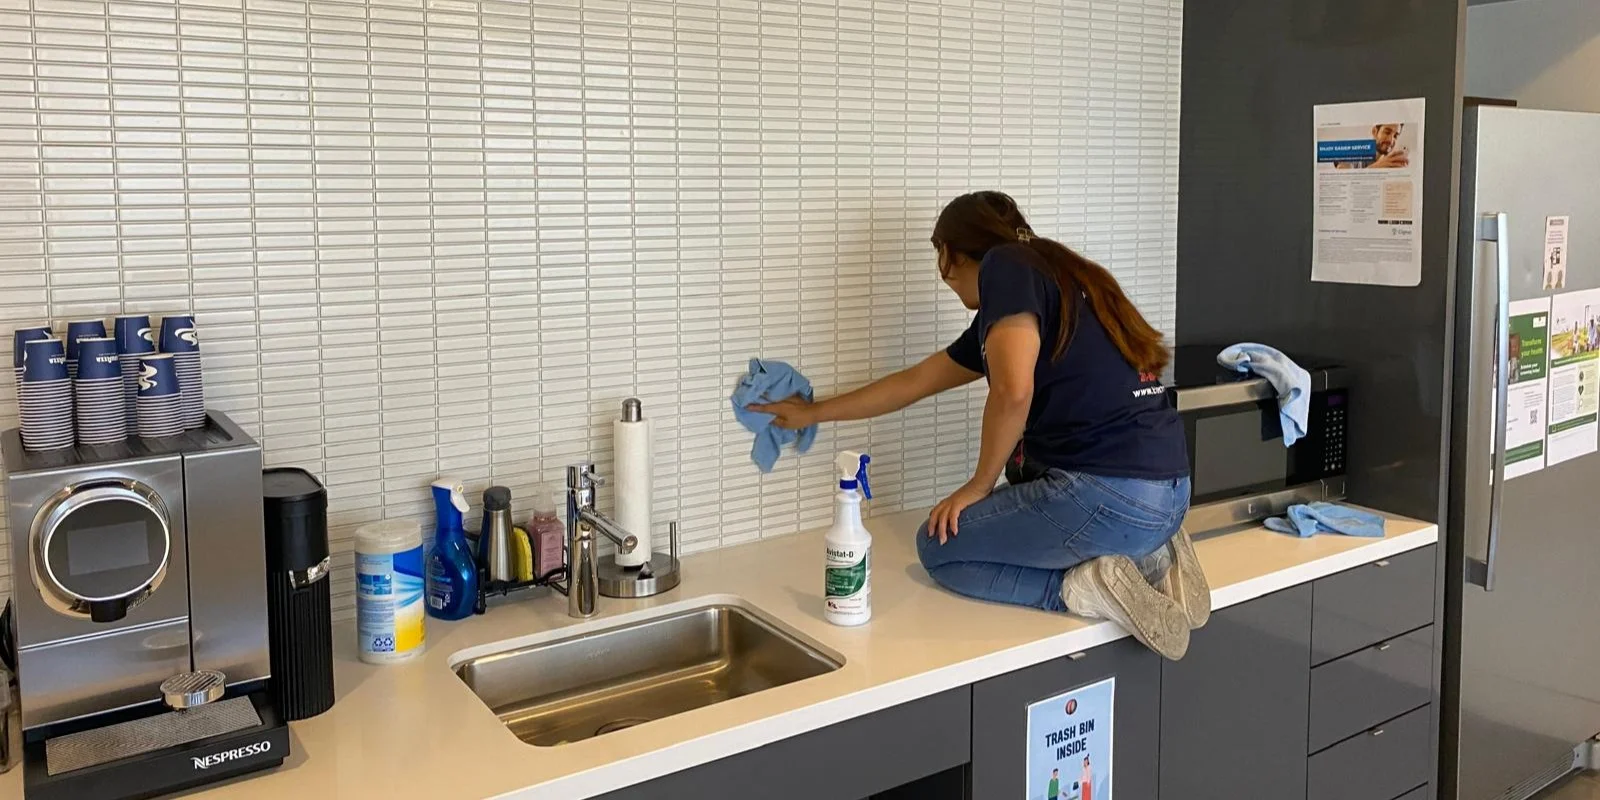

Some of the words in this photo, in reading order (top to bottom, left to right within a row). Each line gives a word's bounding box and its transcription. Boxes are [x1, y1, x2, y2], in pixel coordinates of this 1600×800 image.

[1045, 725, 1076, 748] TRASH
[1079, 718, 1095, 736] BIN
[190, 740, 271, 770] NESPRESSO
[1056, 737, 1087, 761] INSIDE
